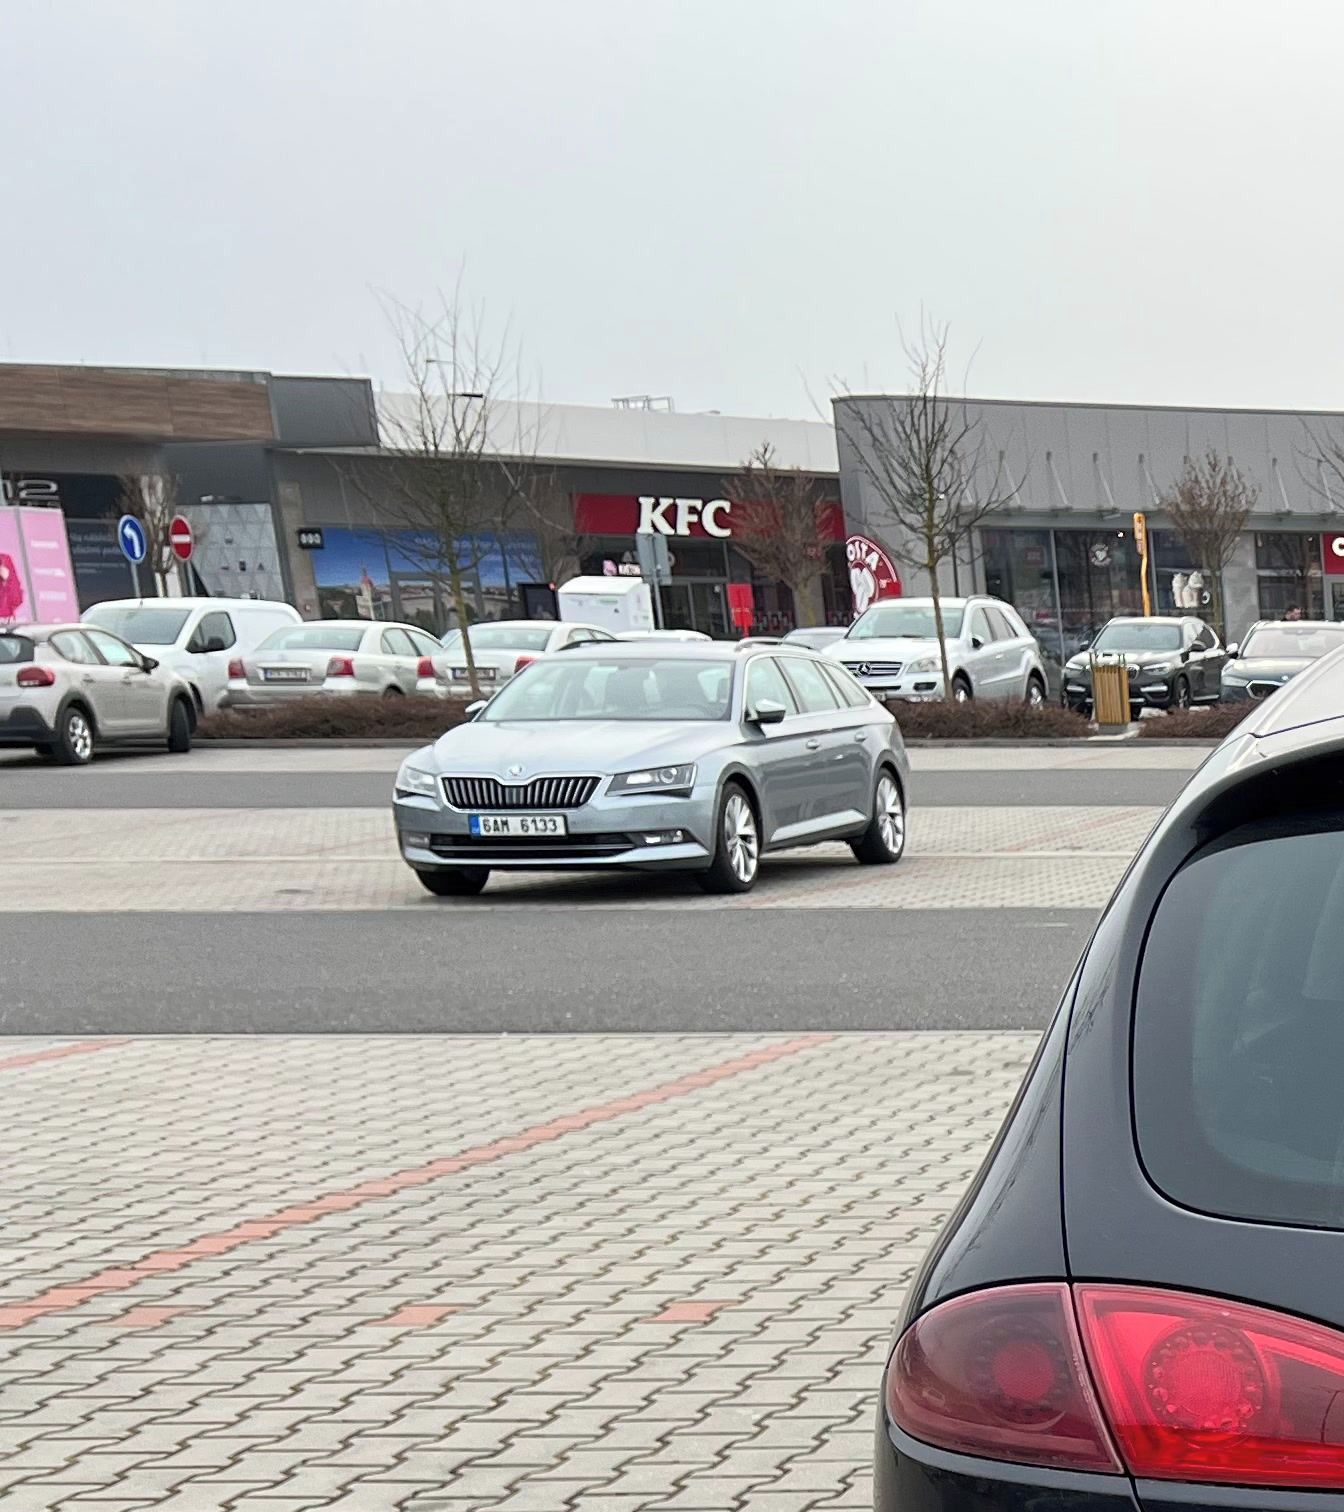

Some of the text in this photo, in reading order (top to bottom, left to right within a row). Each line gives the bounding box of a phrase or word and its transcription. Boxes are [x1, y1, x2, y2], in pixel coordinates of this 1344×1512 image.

[5, 479, 61, 500] 2
[637, 497, 732, 537] KFC
[847, 541, 880, 571] OSTA
[482, 816, 557, 833] 6AM 6133
